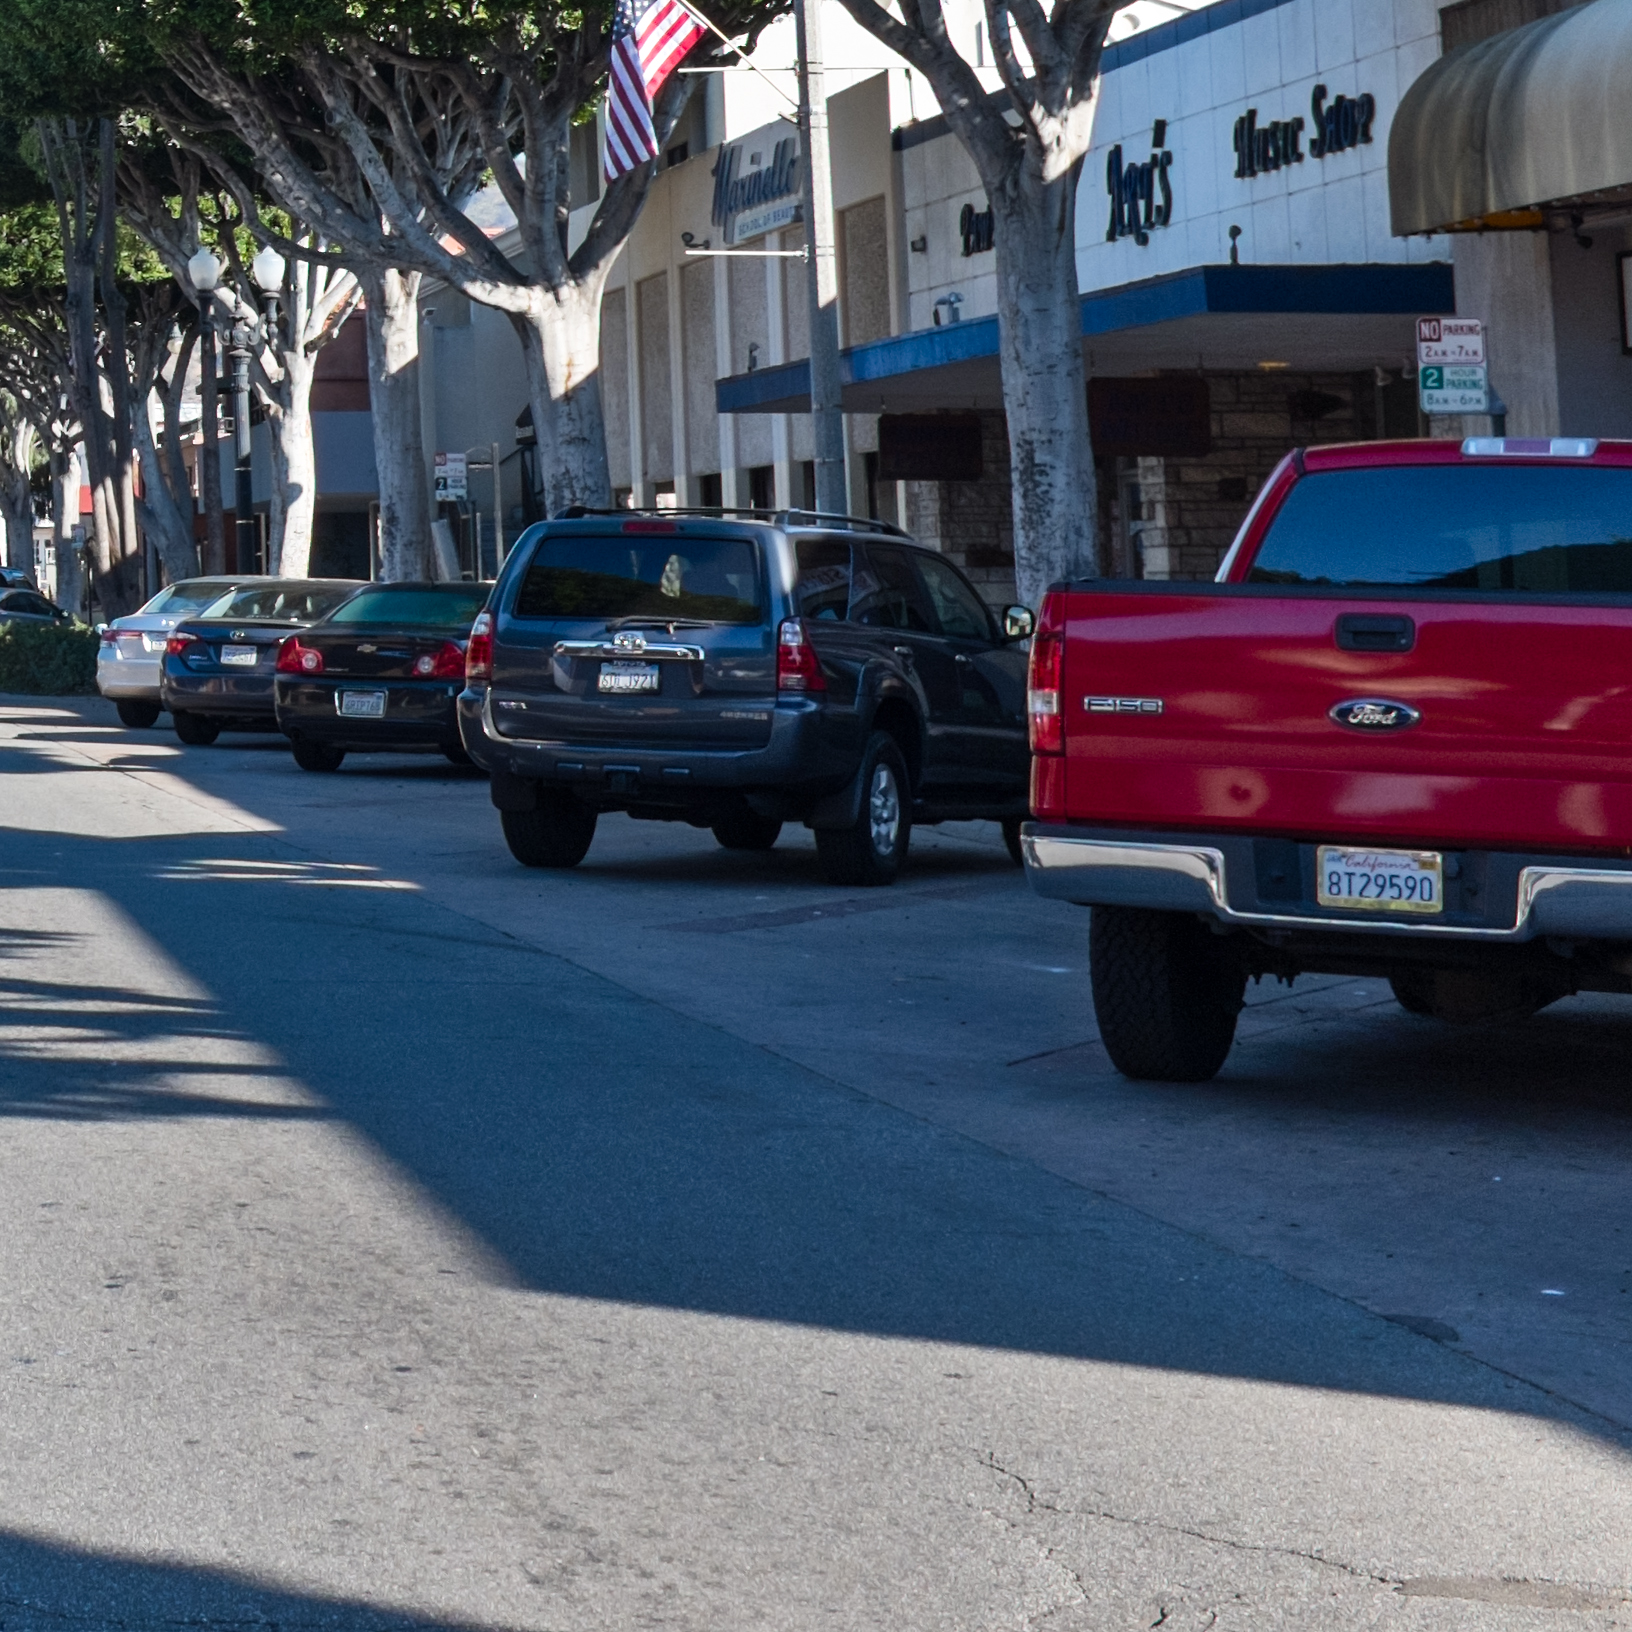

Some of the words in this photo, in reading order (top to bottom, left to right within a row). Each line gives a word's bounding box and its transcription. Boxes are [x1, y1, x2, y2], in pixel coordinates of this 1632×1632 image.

[773, 206, 793, 223] BEAUT
[1420, 321, 1440, 340] NO
[1443, 324, 1480, 336] PARKING
[1425, 368, 1439, 387] 2
[1450, 368, 1477, 377] HOUR
[1445, 378, 1483, 389] PARKING
[435, 455, 446, 465] NO
[438, 478, 445, 490] 2
[1347, 703, 1398, 725] Ford
[1345, 854, 1419, 873] California
[1328, 870, 1433, 902] 8T29590
